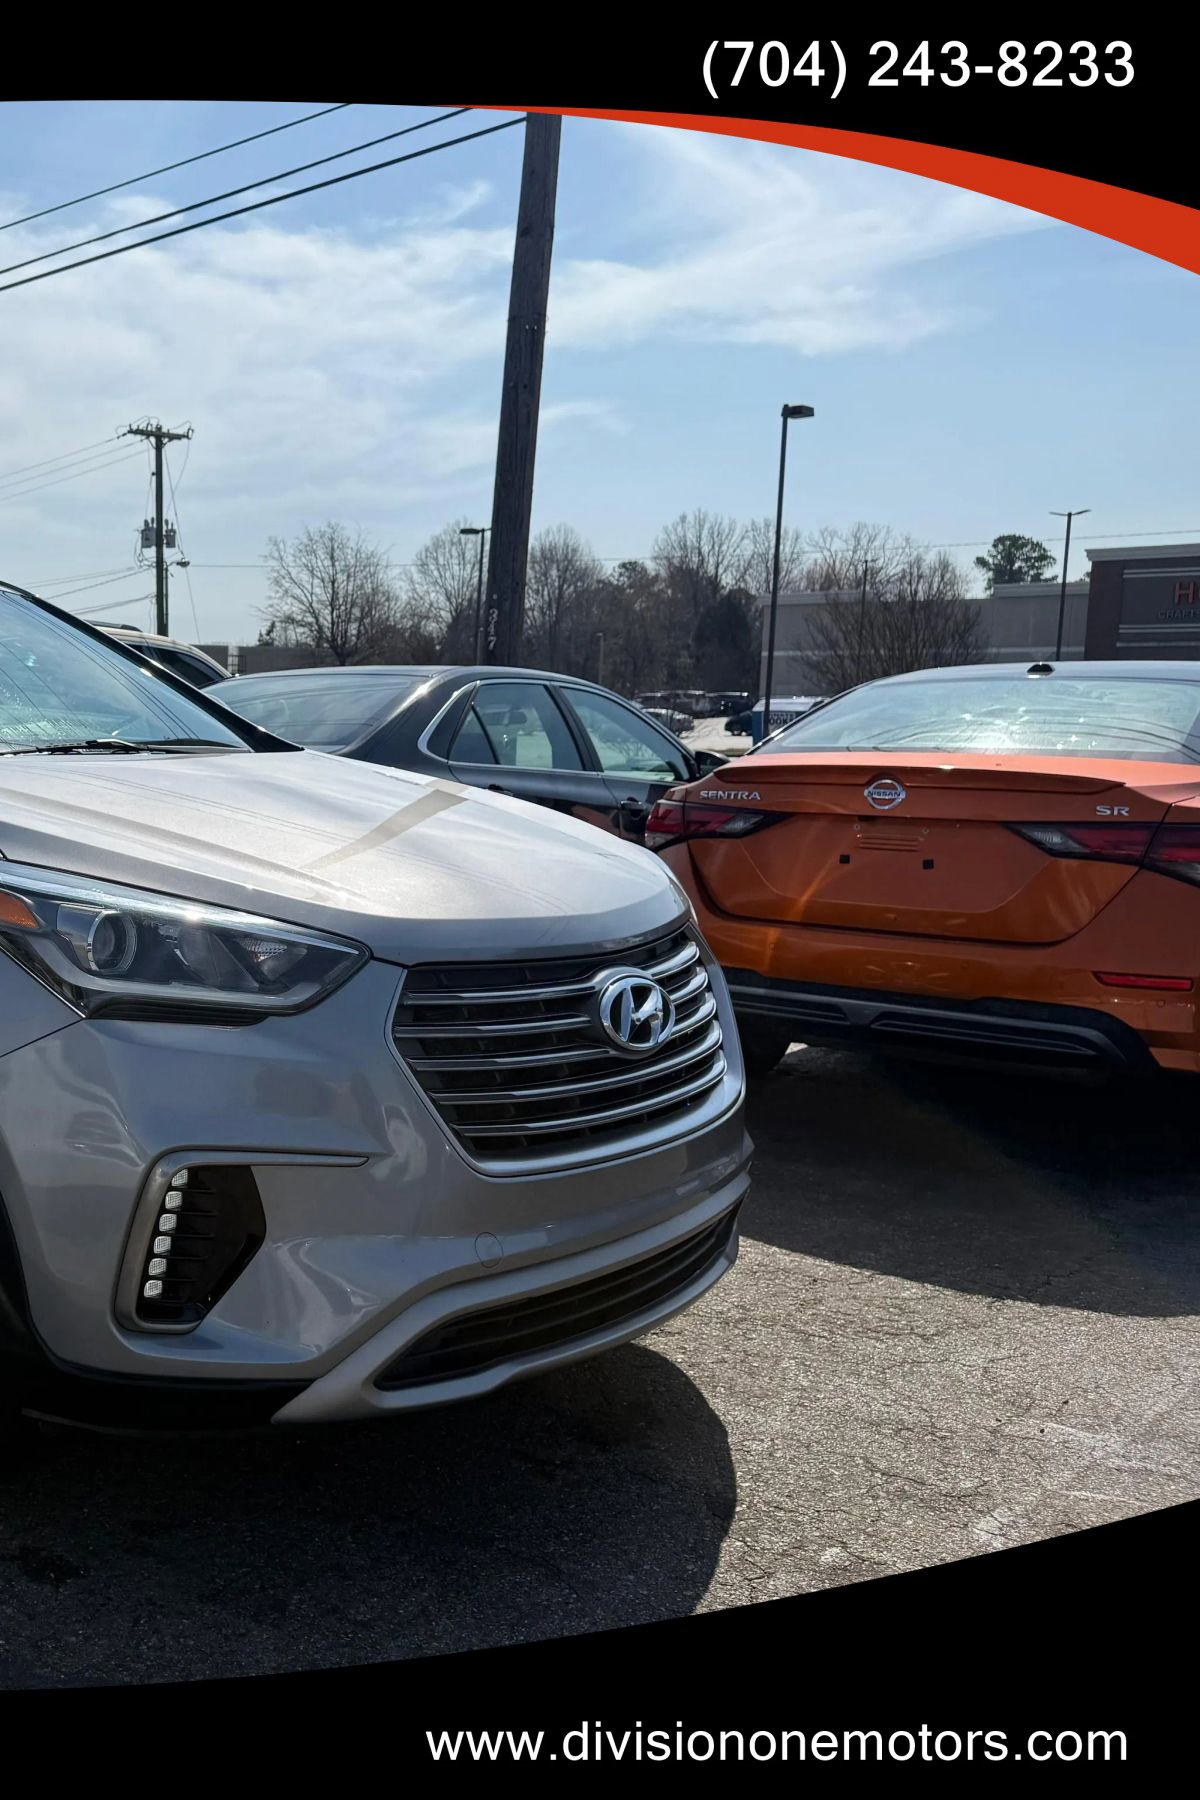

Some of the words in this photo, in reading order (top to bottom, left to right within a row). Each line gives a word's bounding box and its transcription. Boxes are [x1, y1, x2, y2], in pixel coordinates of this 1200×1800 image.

[1174, 582, 1200, 604] H
[699, 790, 761, 801] SENTRA
[866, 789, 901, 799] NISSAN
[1095, 805, 1131, 817] SR
